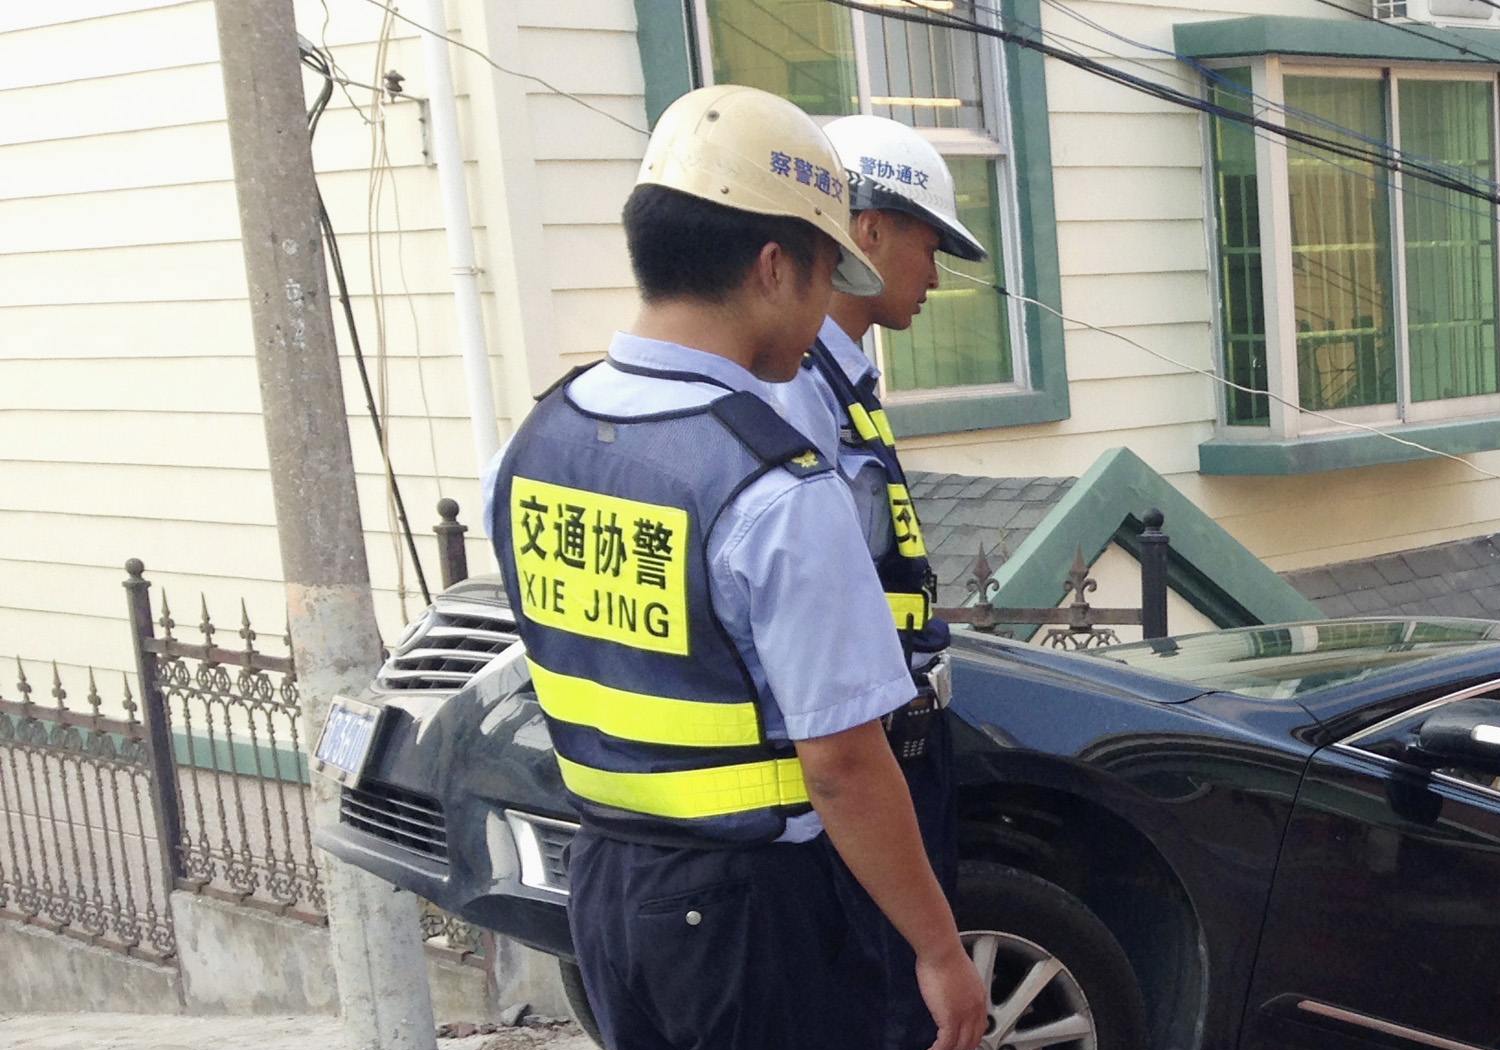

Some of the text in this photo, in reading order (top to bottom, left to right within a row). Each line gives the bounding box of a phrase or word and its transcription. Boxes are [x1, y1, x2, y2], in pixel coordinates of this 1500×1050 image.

[519, 495, 674, 590] 交通协警
[522, 570, 670, 638] XIE JING
